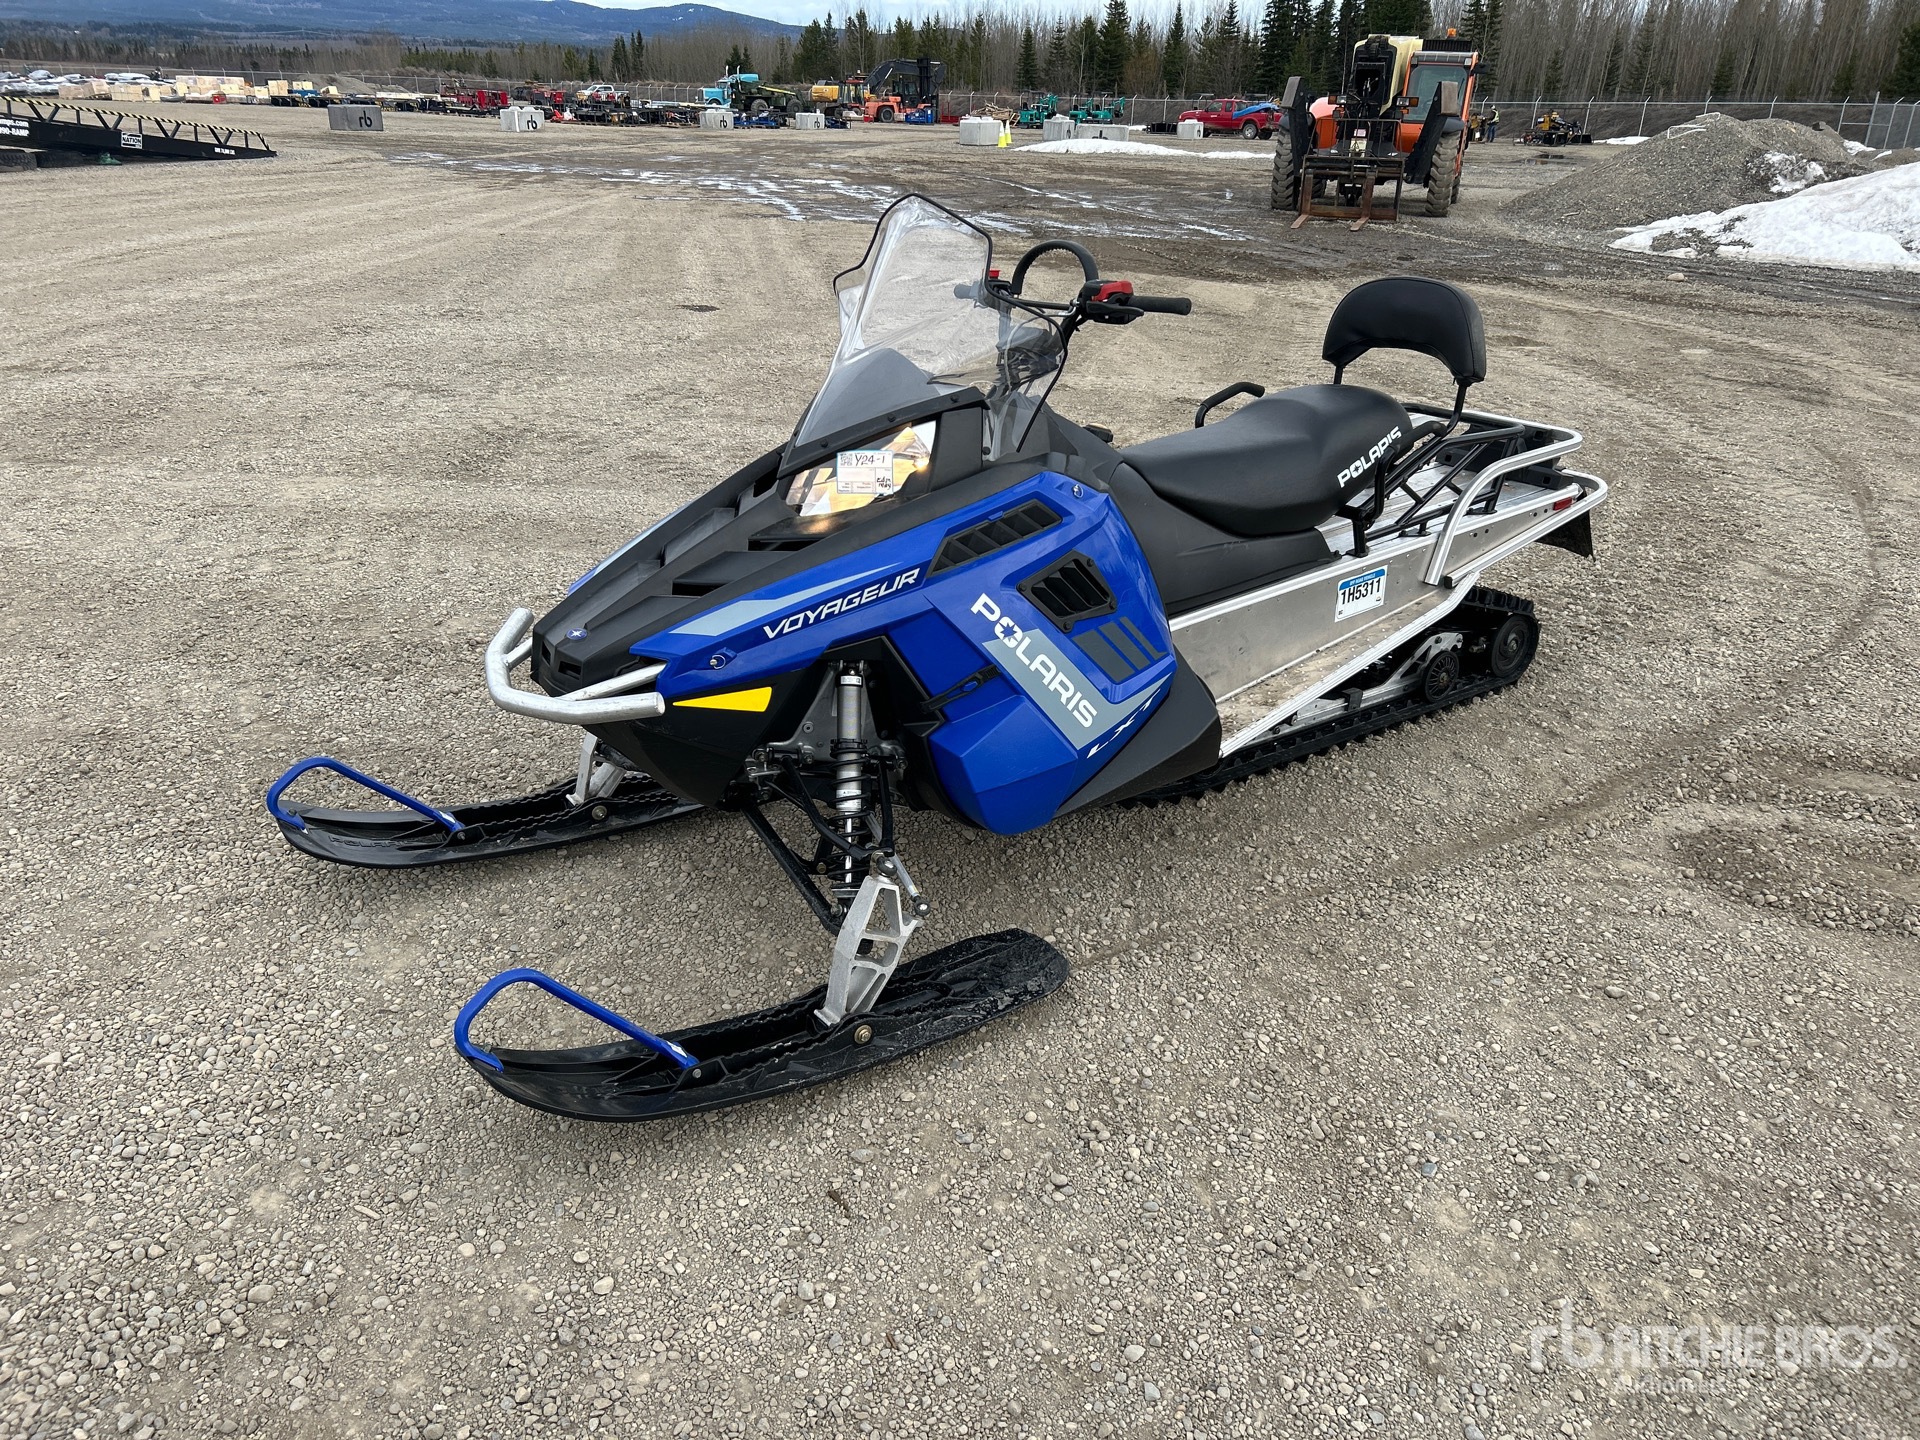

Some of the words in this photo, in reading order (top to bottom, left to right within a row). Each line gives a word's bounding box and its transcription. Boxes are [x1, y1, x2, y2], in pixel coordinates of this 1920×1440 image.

[358, 110, 373, 128] rb
[526, 114, 538, 130] rb
[719, 115, 728, 129] rb
[1336, 425, 1402, 489] POLARIS
[763, 567, 921, 640] VOYAGEUR
[1340, 577, 1381, 605] 1H5311
[970, 592, 1098, 729] POLARIS
[1086, 688, 1161, 759] LXT
